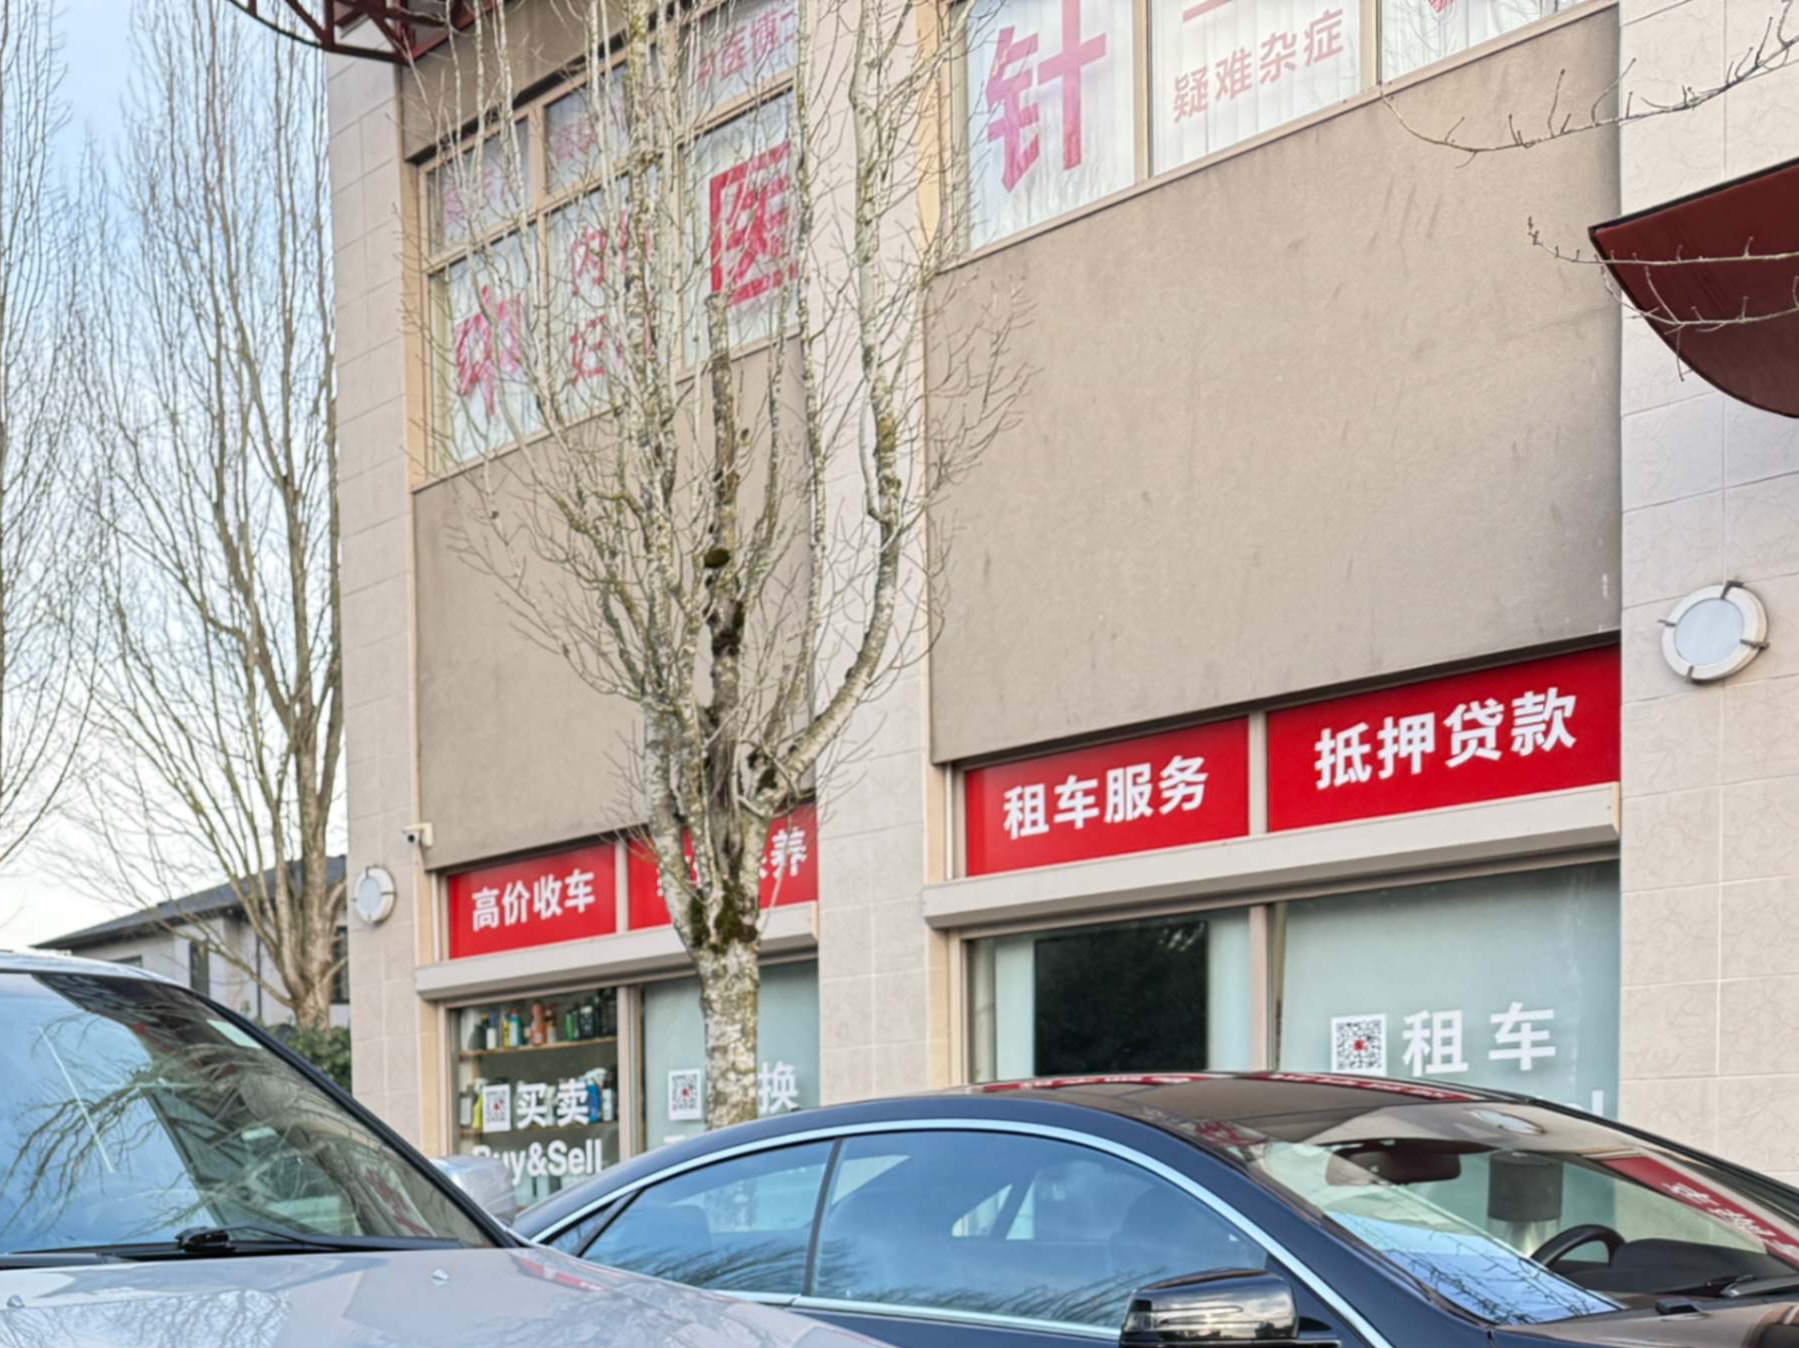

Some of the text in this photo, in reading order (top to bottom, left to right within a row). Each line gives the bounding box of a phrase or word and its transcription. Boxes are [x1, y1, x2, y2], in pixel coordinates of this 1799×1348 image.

[985, 0, 1107, 193] 针
[1173, 8, 1344, 124] 疑难杂症
[1314, 686, 1578, 790] 抵押贷款
[1003, 754, 1209, 840] 租车服务
[471, 867, 595, 932] 高价收车
[1402, 1001, 1557, 1077] 租车
[516, 1079, 589, 1129] 买卖
